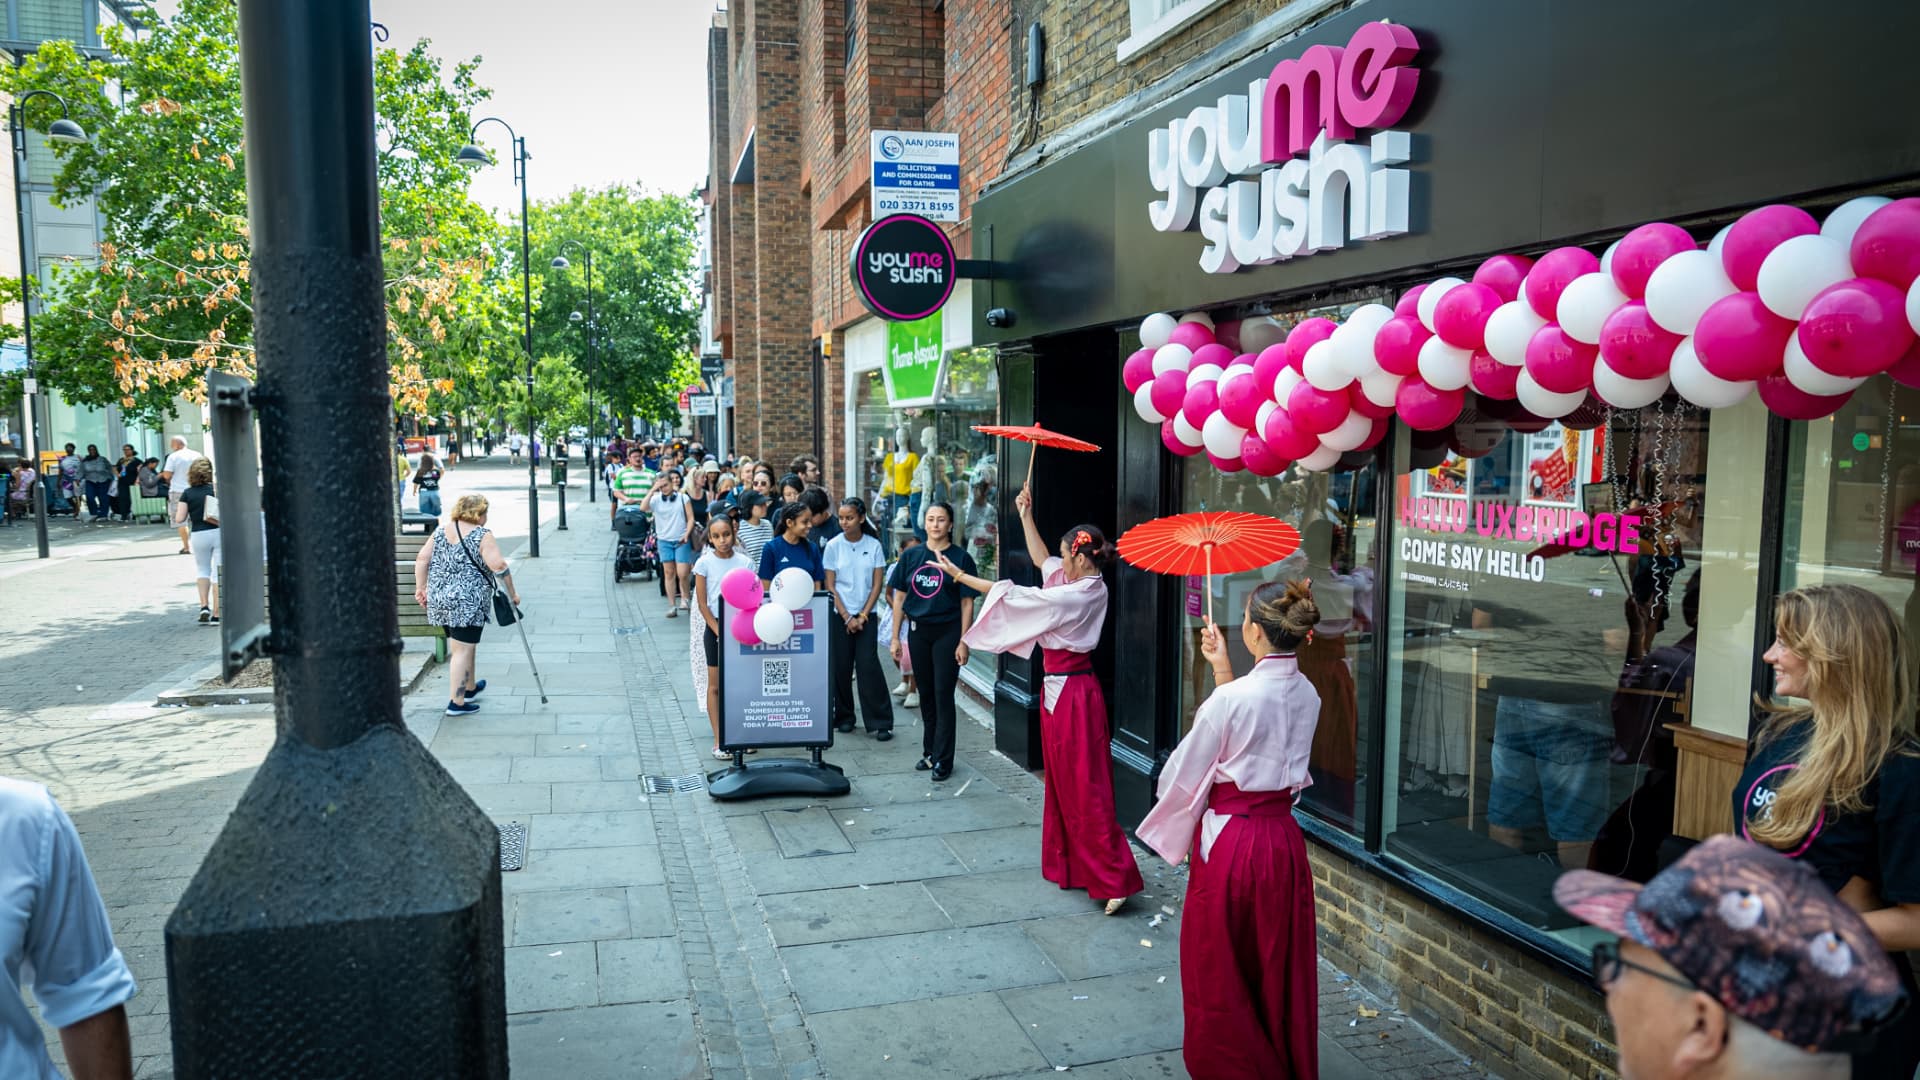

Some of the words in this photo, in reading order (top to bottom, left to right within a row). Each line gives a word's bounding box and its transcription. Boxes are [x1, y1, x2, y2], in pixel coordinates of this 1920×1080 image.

[905, 138, 923, 147] AAN
[925, 139, 955, 149] JOSEPH
[881, 171, 896, 179] AND
[897, 172, 952, 181] COMMISSIONERS
[897, 164, 937, 172] SOLICITORS
[913, 180, 935, 188] OATHS
[880, 200, 899, 209] 020
[902, 201, 926, 210] 3371
[929, 202, 954, 212] 8195
[1199, 128, 1411, 274] sushi
[869, 252, 943, 273] youme
[889, 266, 943, 284] sushi
[1400, 495, 1469, 534] HELLO
[1475, 502, 1642, 555] UXBRIDGE
[1401, 537, 1447, 568] COME
[1450, 543, 1484, 573] SAY
[1486, 548, 1545, 583] HELLO
[1438, 576, 1469, 592] こんにちは
